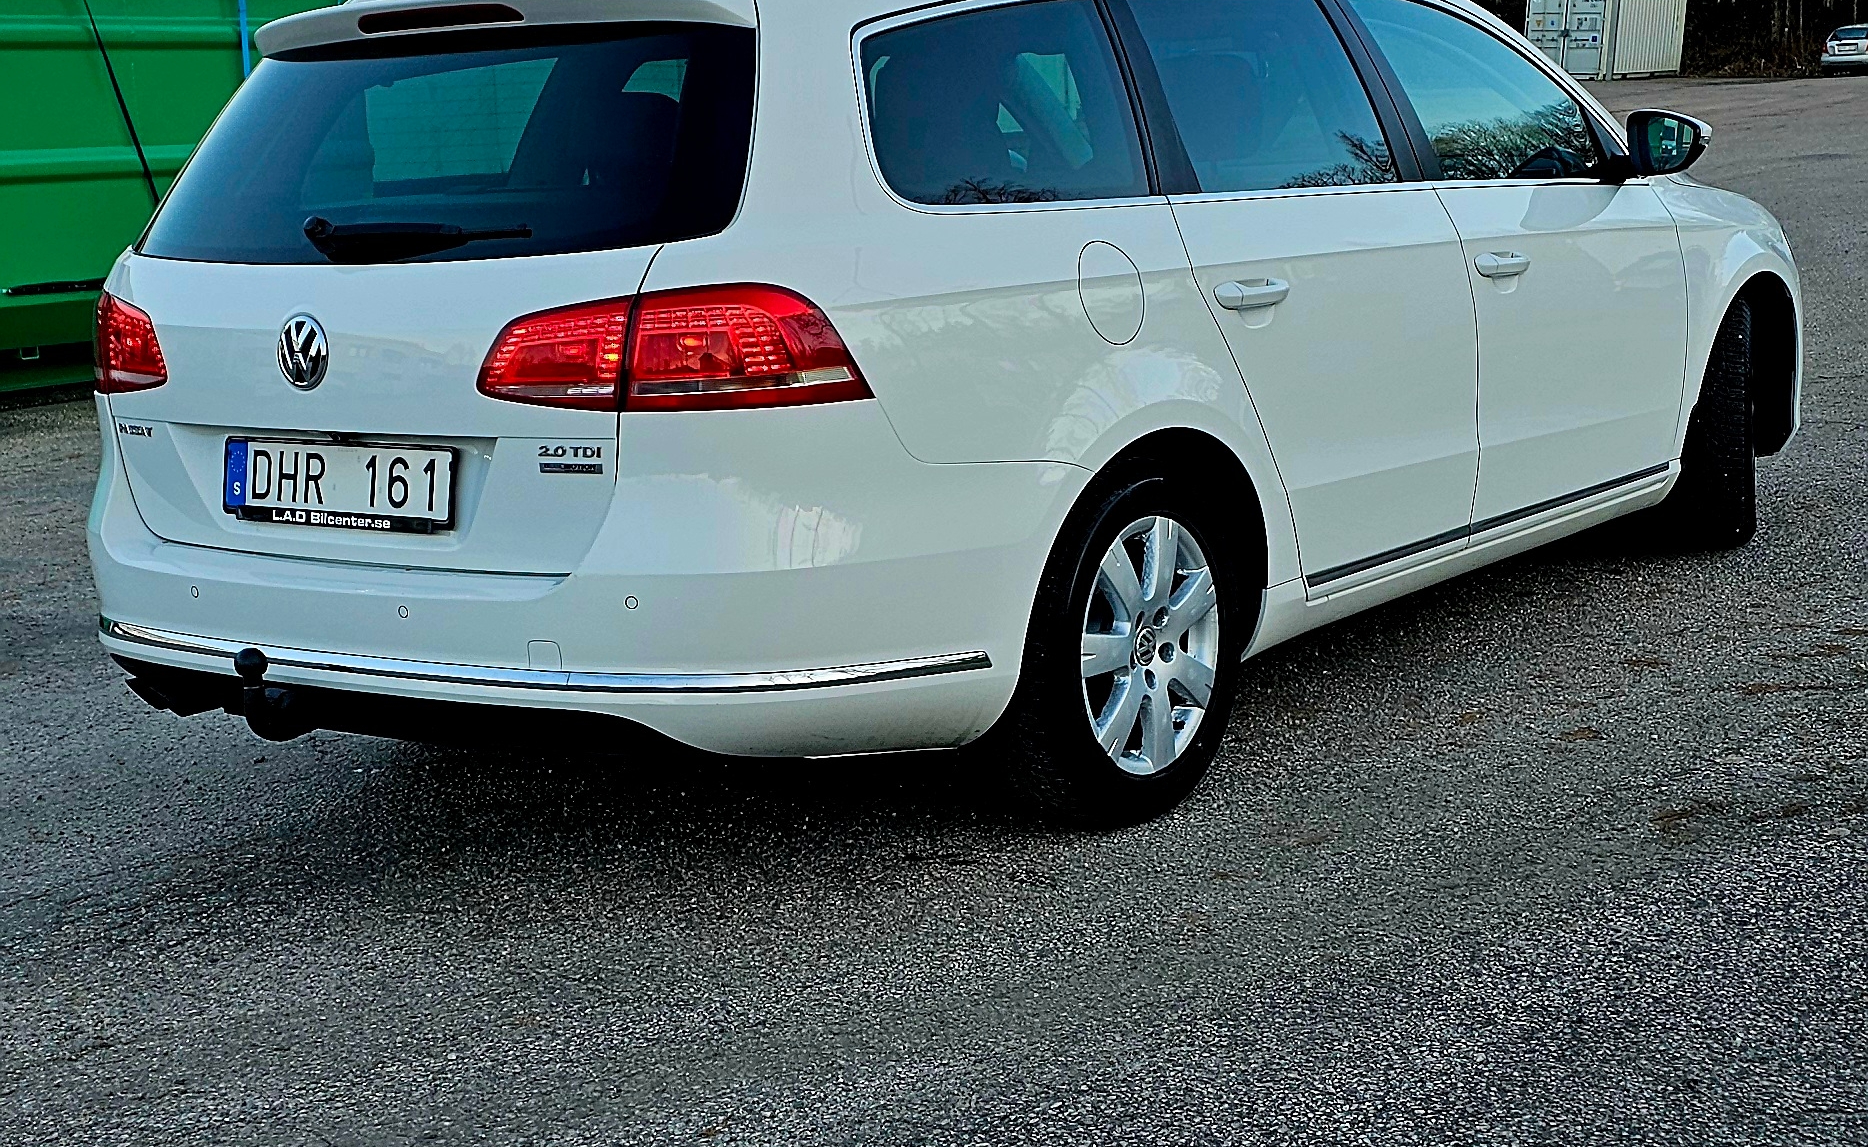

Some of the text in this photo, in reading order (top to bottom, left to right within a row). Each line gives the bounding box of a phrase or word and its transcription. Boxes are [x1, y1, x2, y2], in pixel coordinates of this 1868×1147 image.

[569, 446, 602, 458] TDI
[233, 481, 241, 496] S
[251, 449, 437, 512] DHR 161
[310, 511, 391, 529] Bilcenter.se
